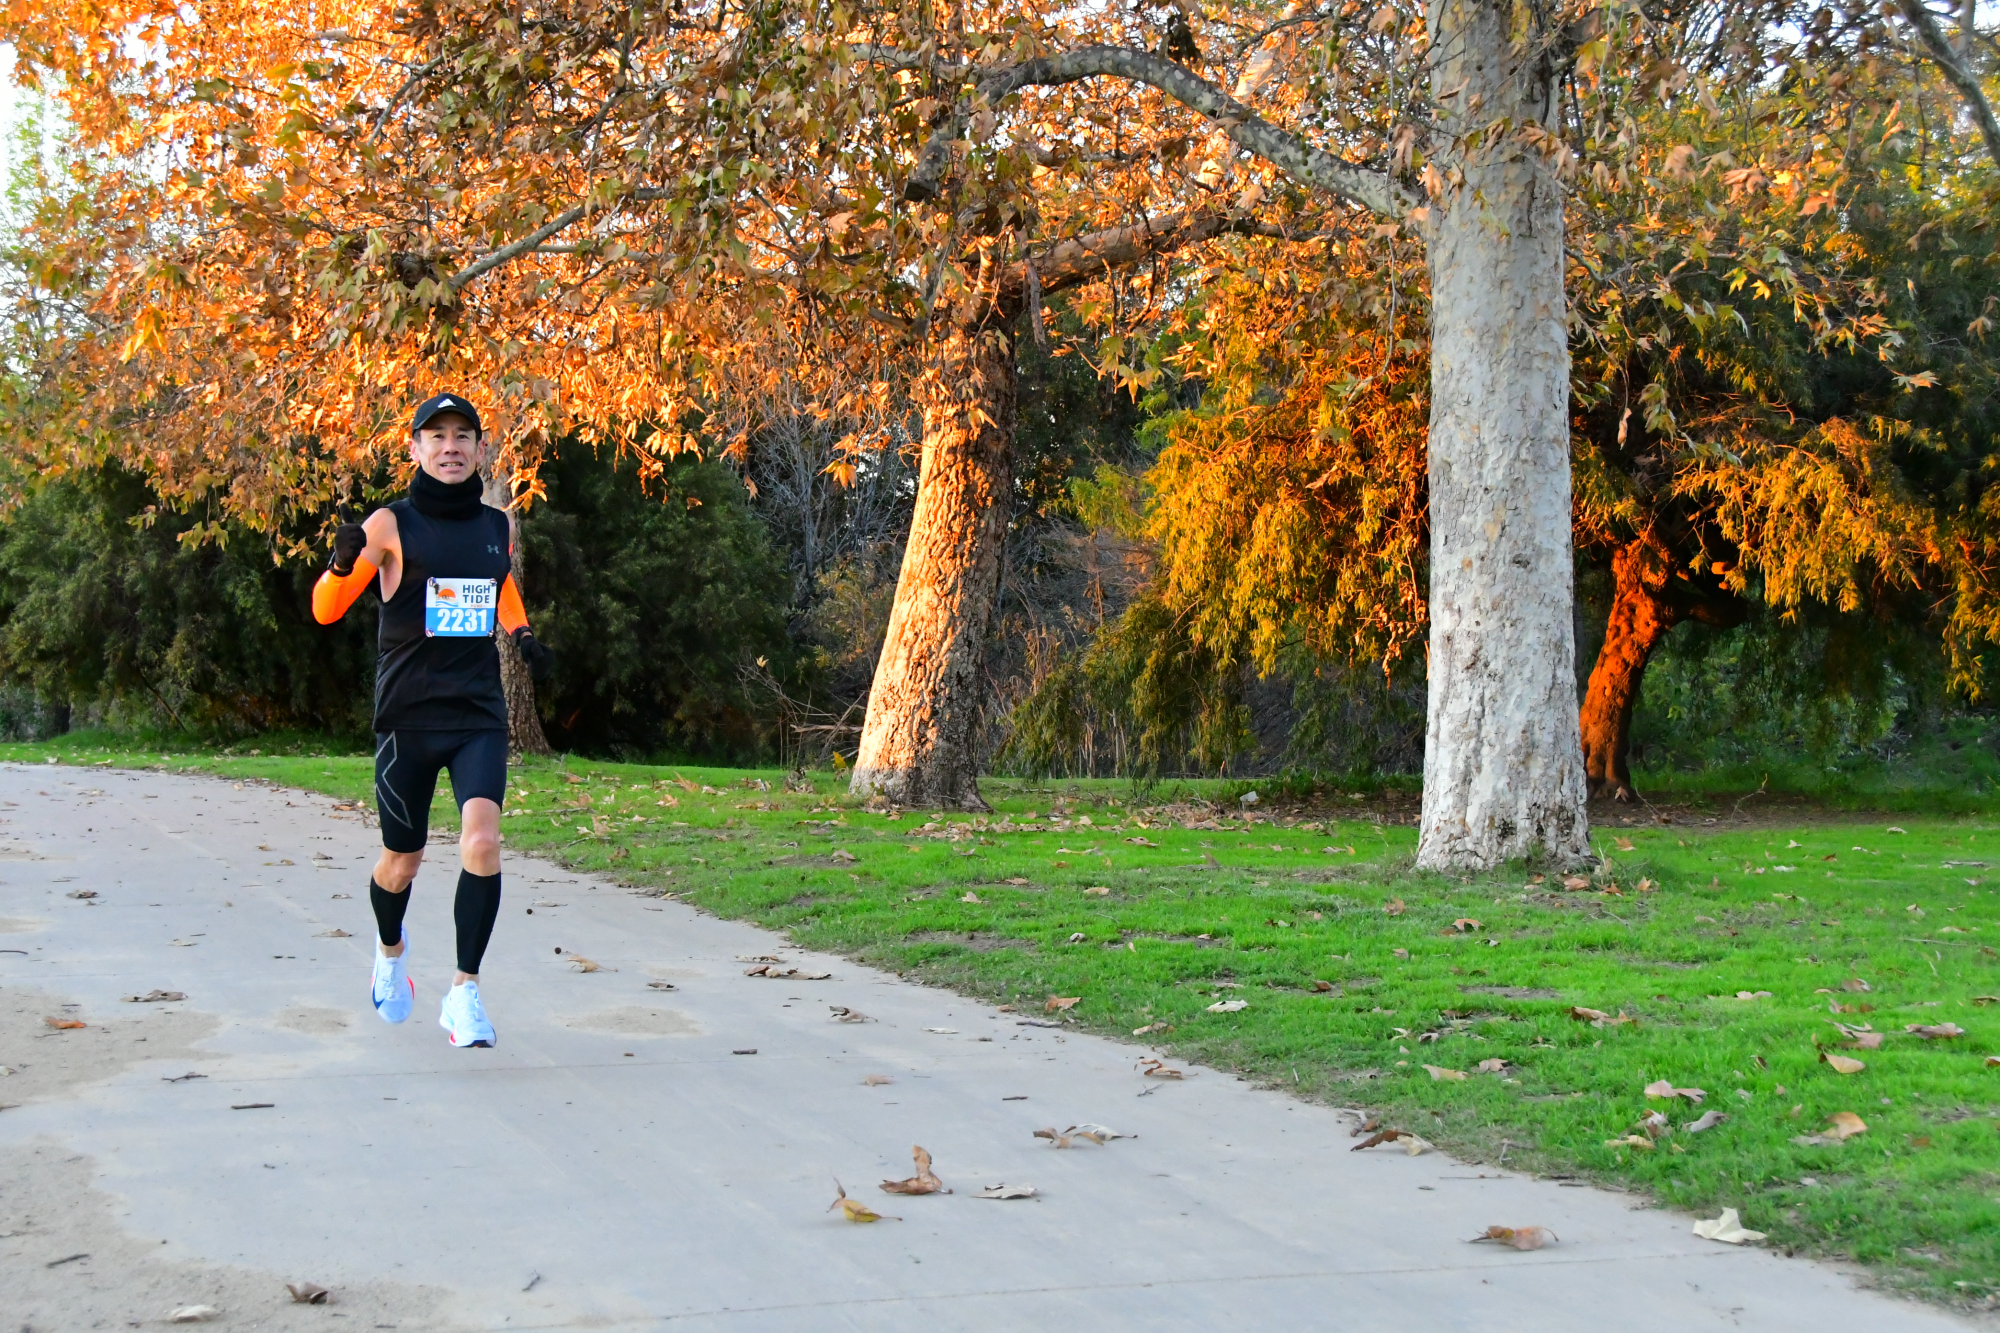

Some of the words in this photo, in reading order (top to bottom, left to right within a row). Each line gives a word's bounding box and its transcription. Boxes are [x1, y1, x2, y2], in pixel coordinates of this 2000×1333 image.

[462, 584, 490, 594] HIGH
[462, 594, 490, 604] TIDE
[437, 608, 487, 632] 2231
